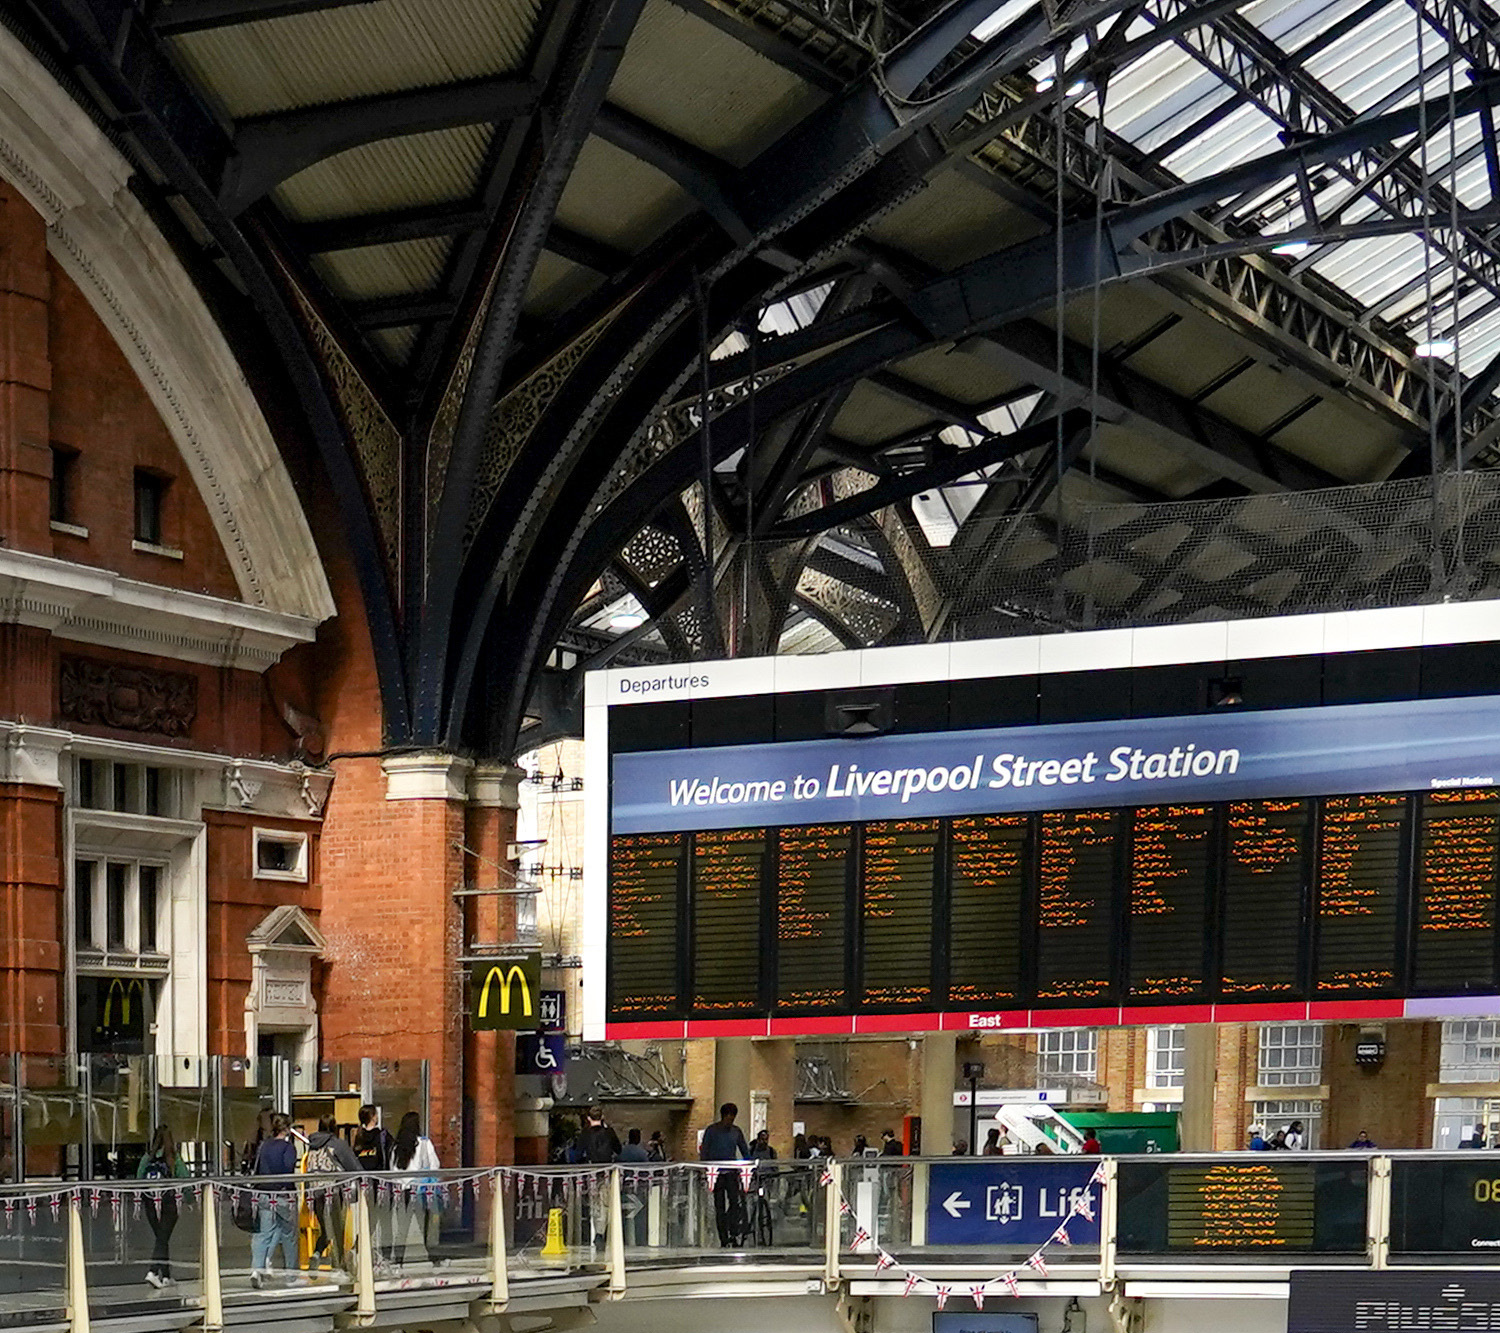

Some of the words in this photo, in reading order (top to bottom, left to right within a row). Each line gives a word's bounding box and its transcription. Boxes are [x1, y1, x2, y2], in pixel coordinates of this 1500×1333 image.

[620, 675, 709, 694] Departures
[669, 777, 785, 807] Welcome
[794, 774, 819, 799] to
[826, 755, 982, 803] Liverpool
[990, 750, 1098, 789] Street
[1105, 743, 1239, 781] Station
[969, 1014, 1001, 1027] East
[1039, 1187, 1096, 1217] Lift
[1471, 1239, 1500, 1248] Connect
